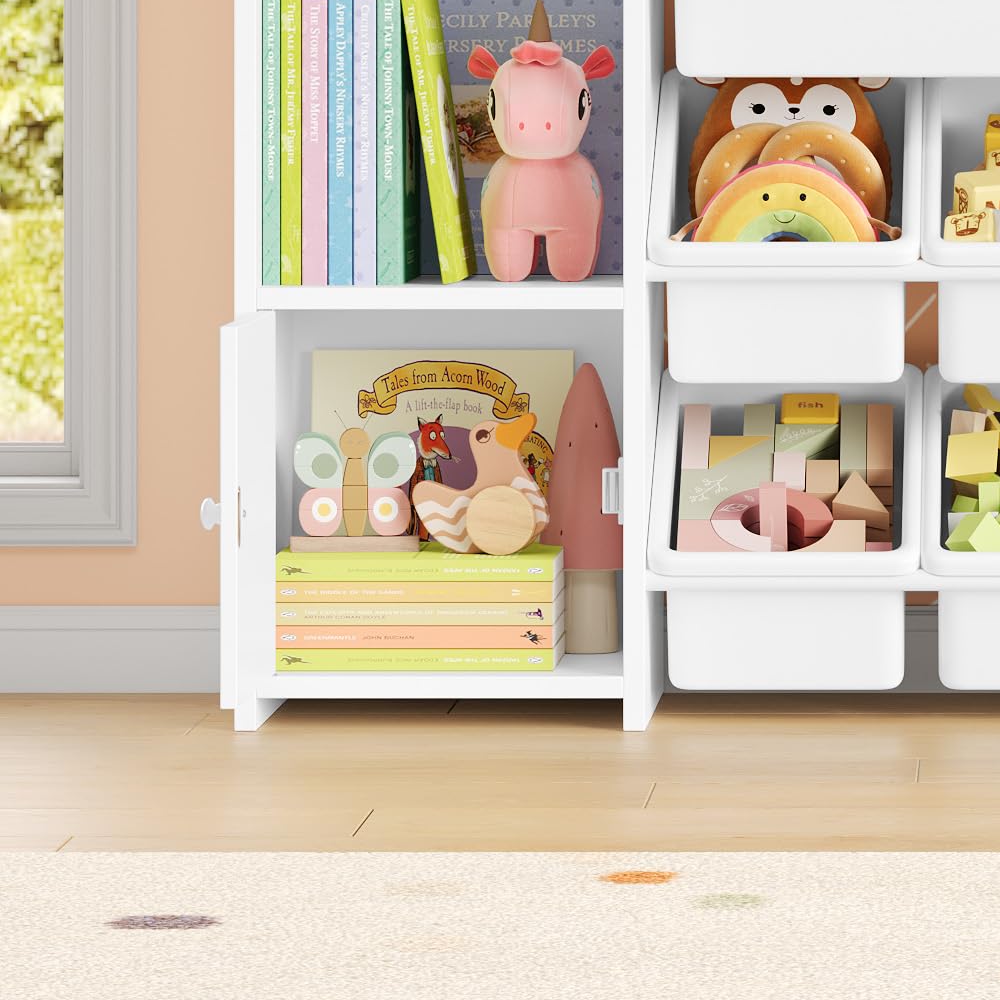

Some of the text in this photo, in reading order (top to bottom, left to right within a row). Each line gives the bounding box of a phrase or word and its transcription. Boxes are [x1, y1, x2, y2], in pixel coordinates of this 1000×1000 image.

[310, 28, 320, 58] STORY
[310, 76, 320, 100] MISS
[335, 3, 346, 177] APPLEY DAPPLY'S NURSERY RHYMES
[383, 65, 394, 106] JOHNNY
[381, 366, 507, 396] Tales from Acorn Wood
[405, 398, 483, 415] A lift-the-flap book
